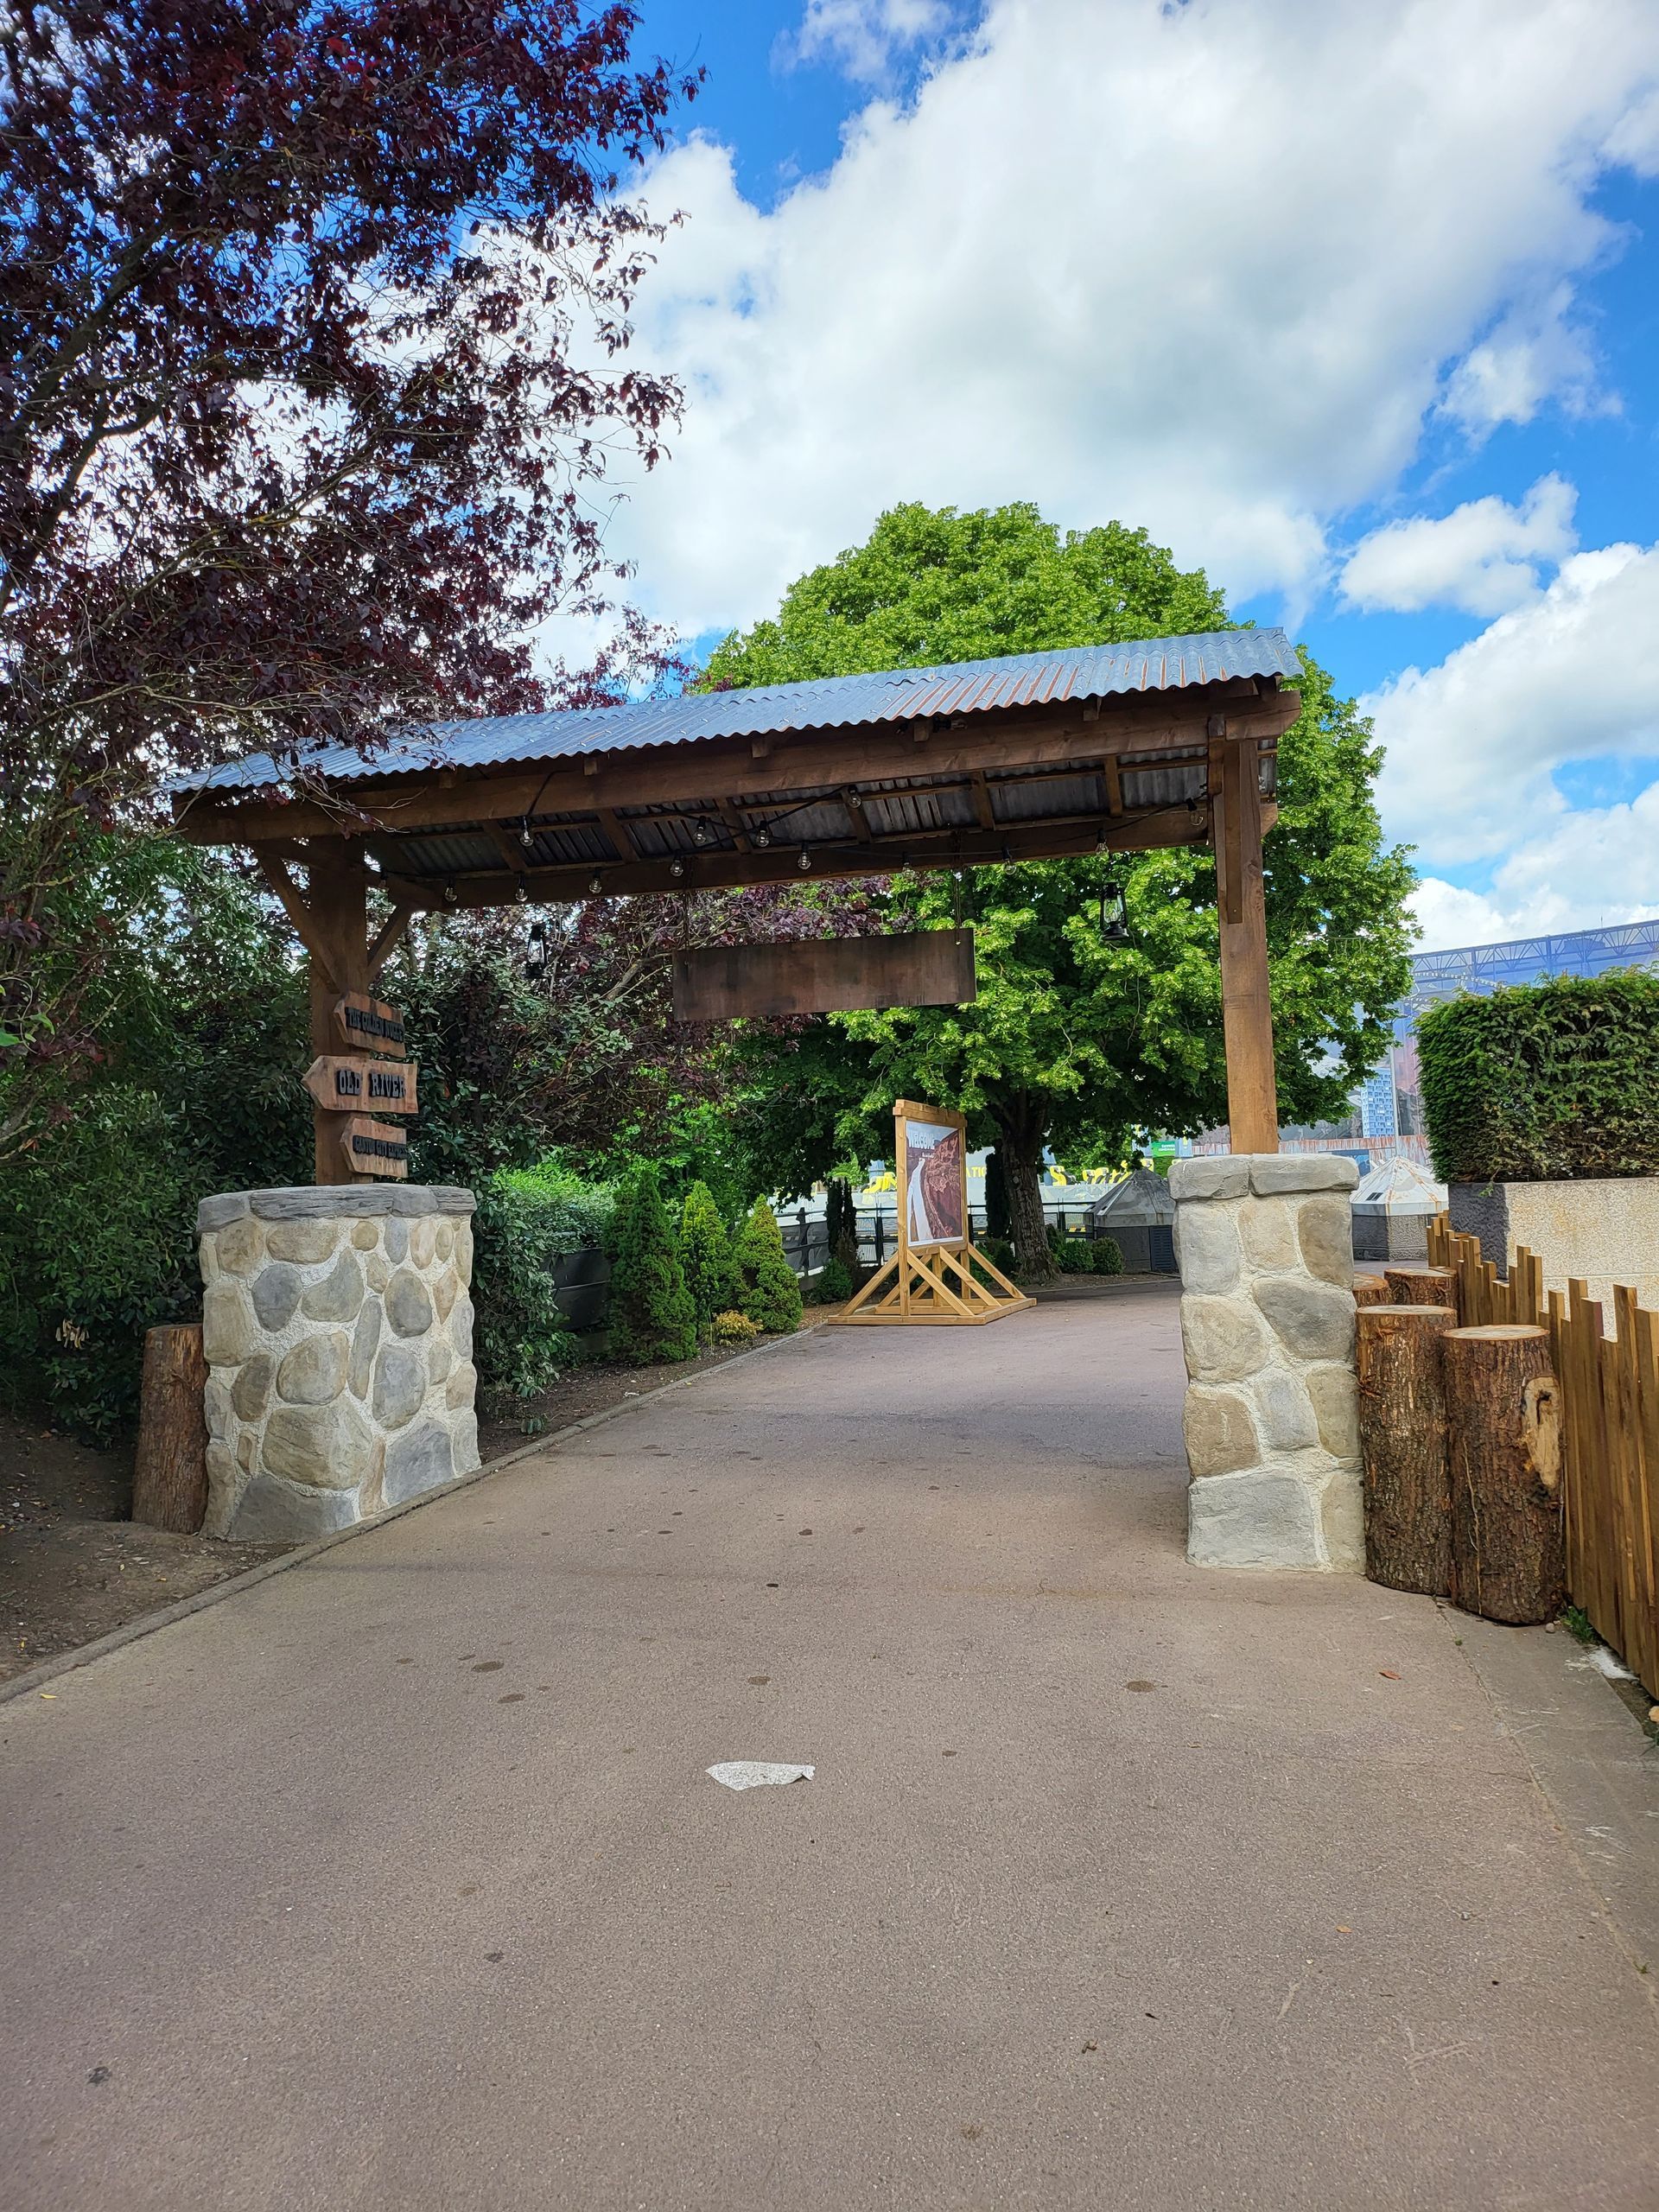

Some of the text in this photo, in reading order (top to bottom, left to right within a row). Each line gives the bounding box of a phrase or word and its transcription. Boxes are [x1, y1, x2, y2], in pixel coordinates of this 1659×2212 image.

[346, 1007, 360, 1028] THE
[338, 1071, 405, 1098] OLD RIVER
[907, 1130, 935, 1149] WELCOME
